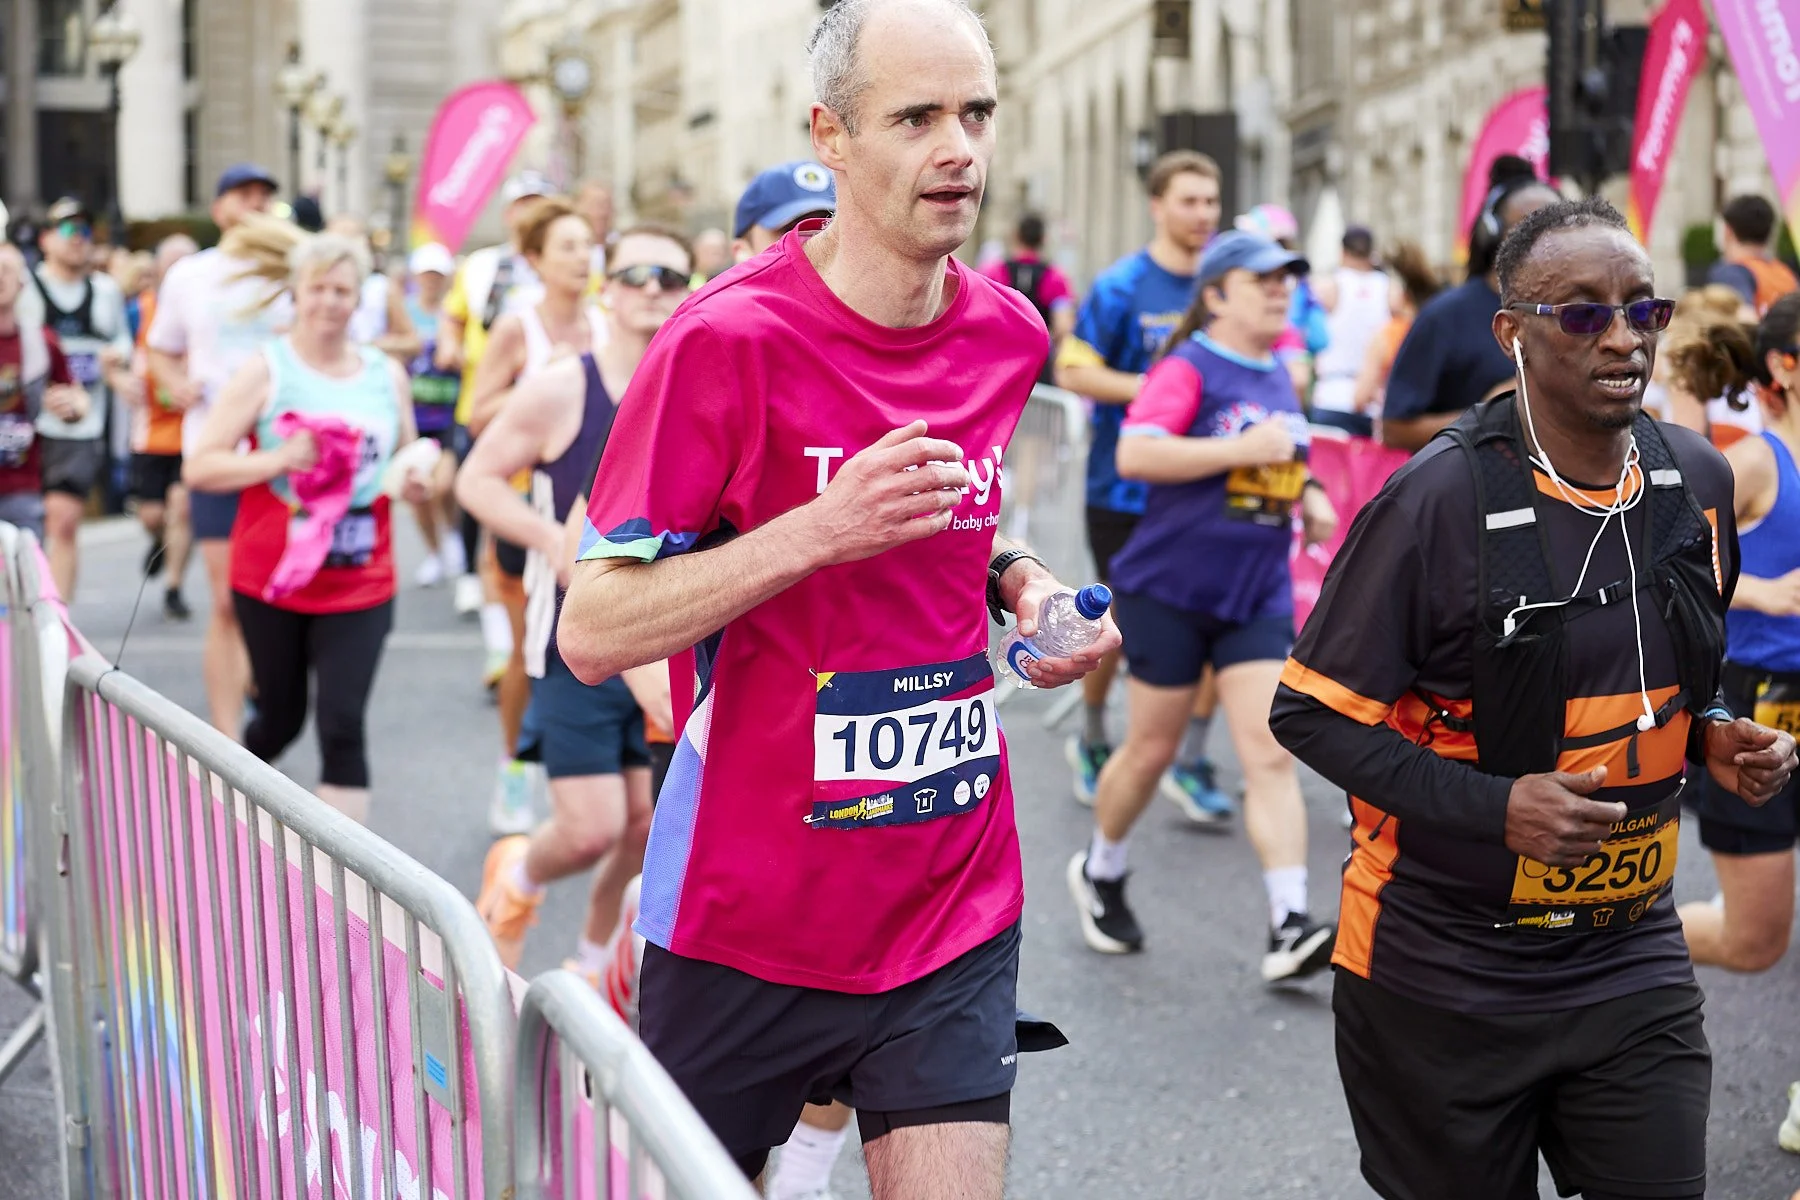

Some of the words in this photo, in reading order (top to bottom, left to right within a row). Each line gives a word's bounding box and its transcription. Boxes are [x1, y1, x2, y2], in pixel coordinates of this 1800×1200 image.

[804, 445, 1003, 505] Ty's
[953, 515, 983, 531] baby
[893, 671, 953, 693] MILLSY
[833, 699, 987, 773] 10749
[829, 804, 859, 820] LONDON
[1609, 813, 1658, 834] ULGANI
[1543, 840, 1662, 893] 3250
